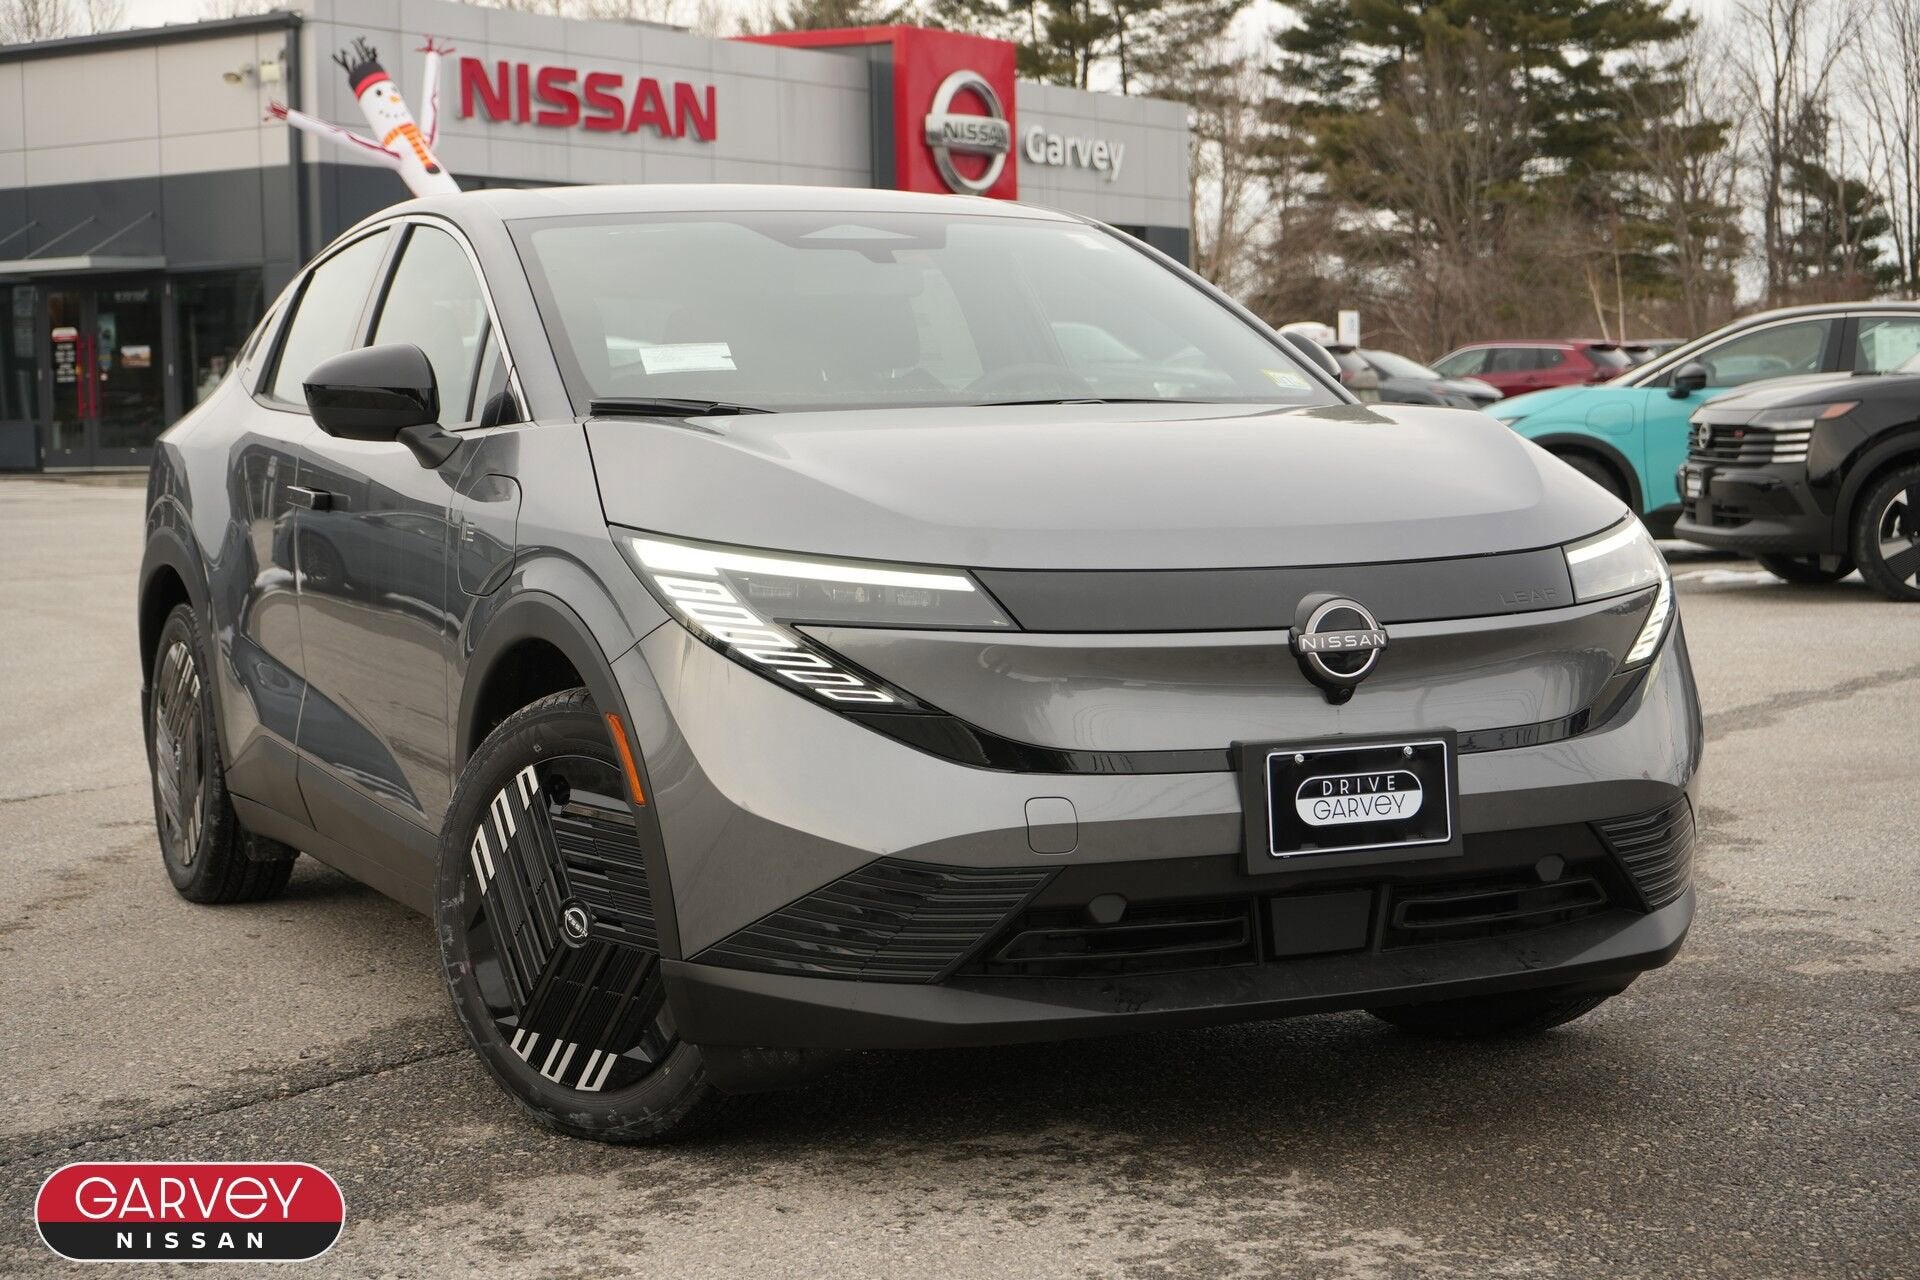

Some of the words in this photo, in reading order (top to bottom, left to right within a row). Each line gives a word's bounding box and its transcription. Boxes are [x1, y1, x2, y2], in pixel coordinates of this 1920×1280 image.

[461, 57, 717, 142] NISSAN
[1025, 125, 1125, 181] Garvey
[1497, 588, 1556, 606] LEAF
[1302, 633, 1385, 649] NISSAN
[1322, 775, 1396, 796] DRIVE
